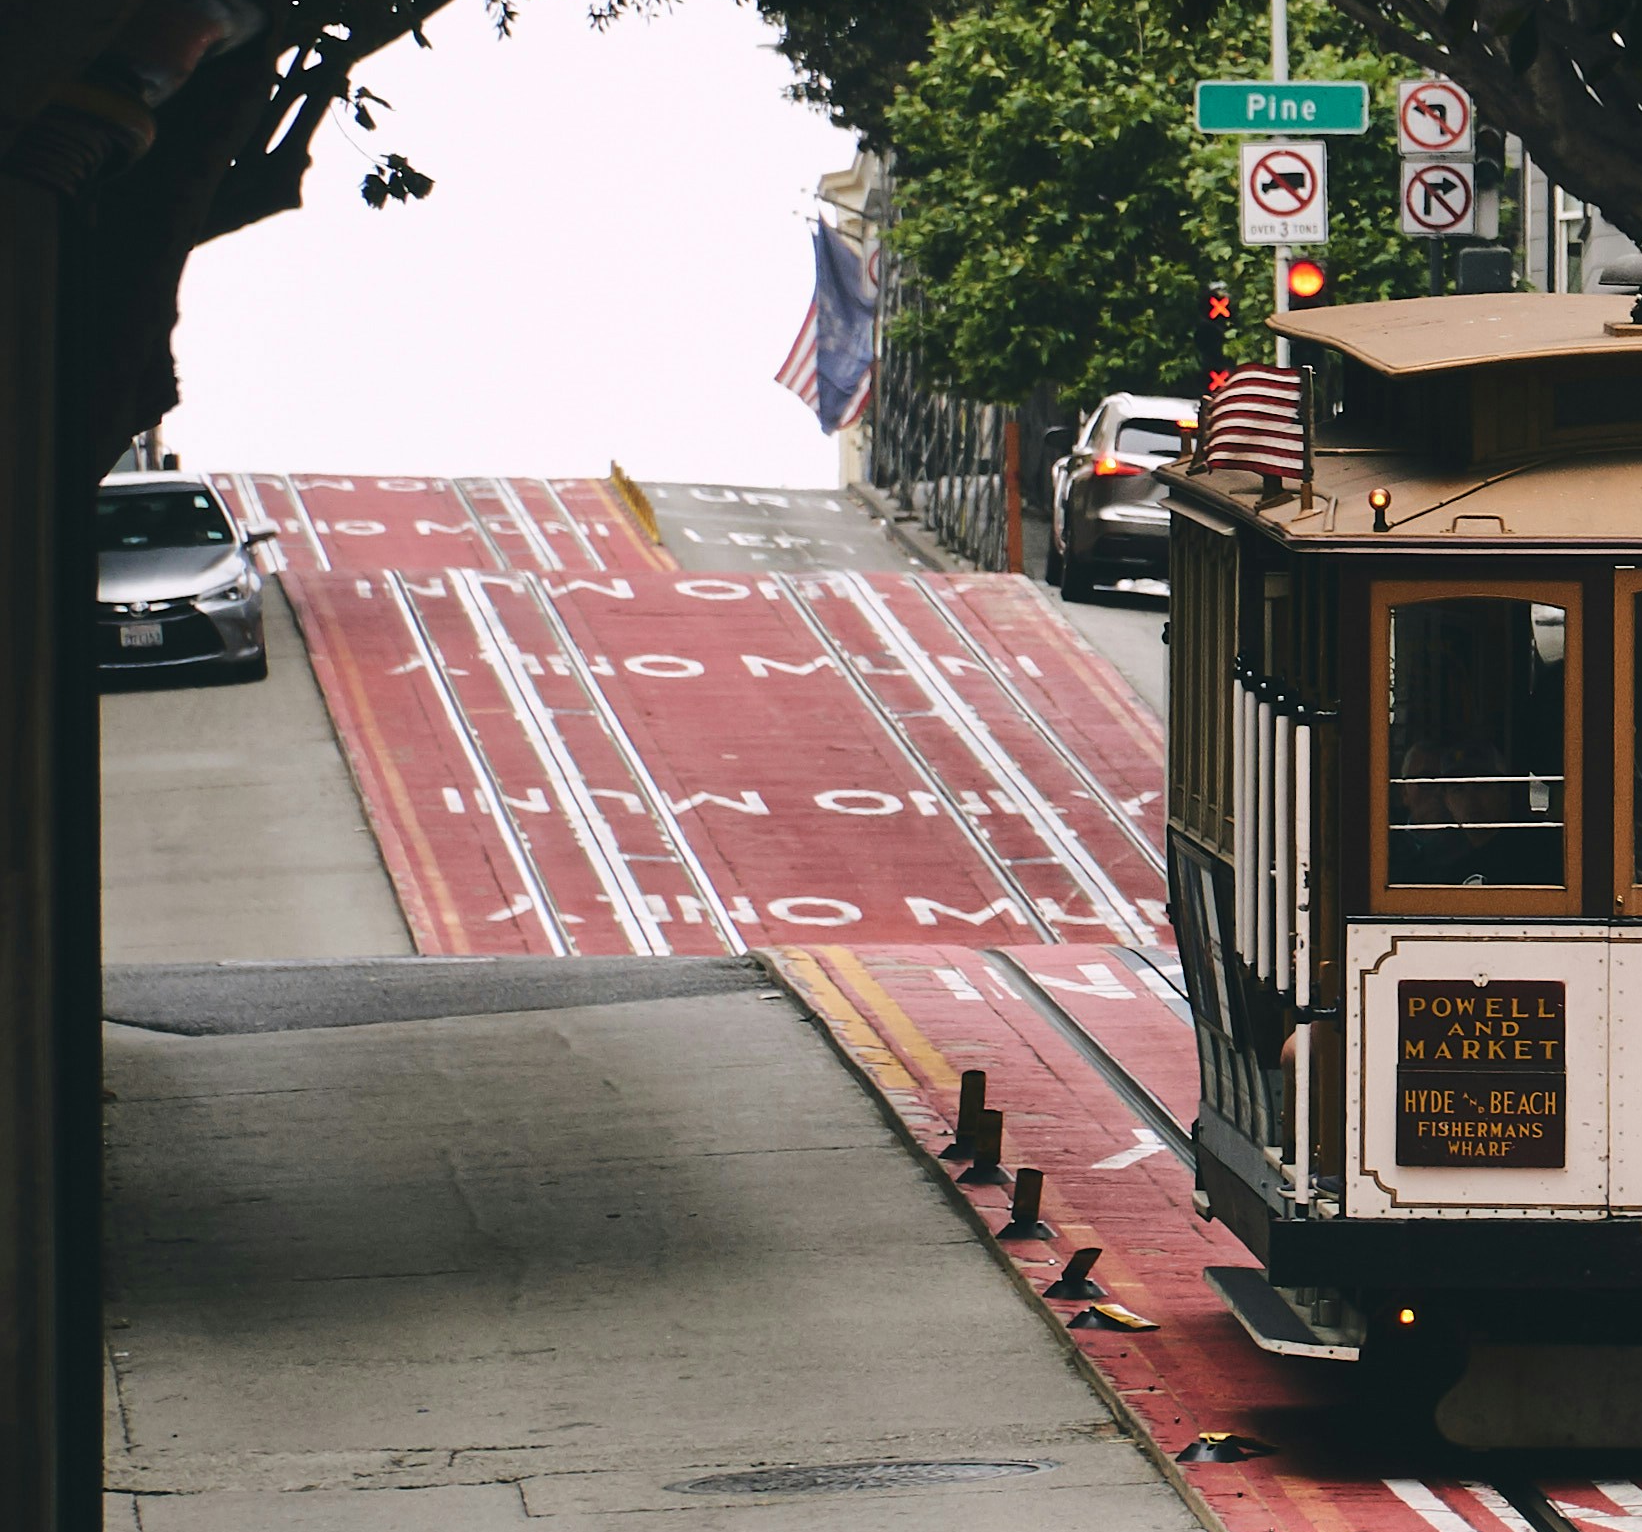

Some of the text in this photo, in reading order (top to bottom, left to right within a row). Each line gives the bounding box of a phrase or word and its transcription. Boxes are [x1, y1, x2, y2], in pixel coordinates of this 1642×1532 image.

[1246, 93, 1317, 122] Pine
[1251, 222, 1319, 238] OVER 3 TONS
[1408, 997, 1556, 1018] POWELL
[1447, 1021, 1520, 1037] AND
[1404, 1040, 1559, 1060] MARKET
[1404, 1090, 1557, 1115] HYDE AND BEACH
[1418, 1122, 1544, 1138] FISHERMANS
[1448, 1141, 1513, 1157] WHARF
